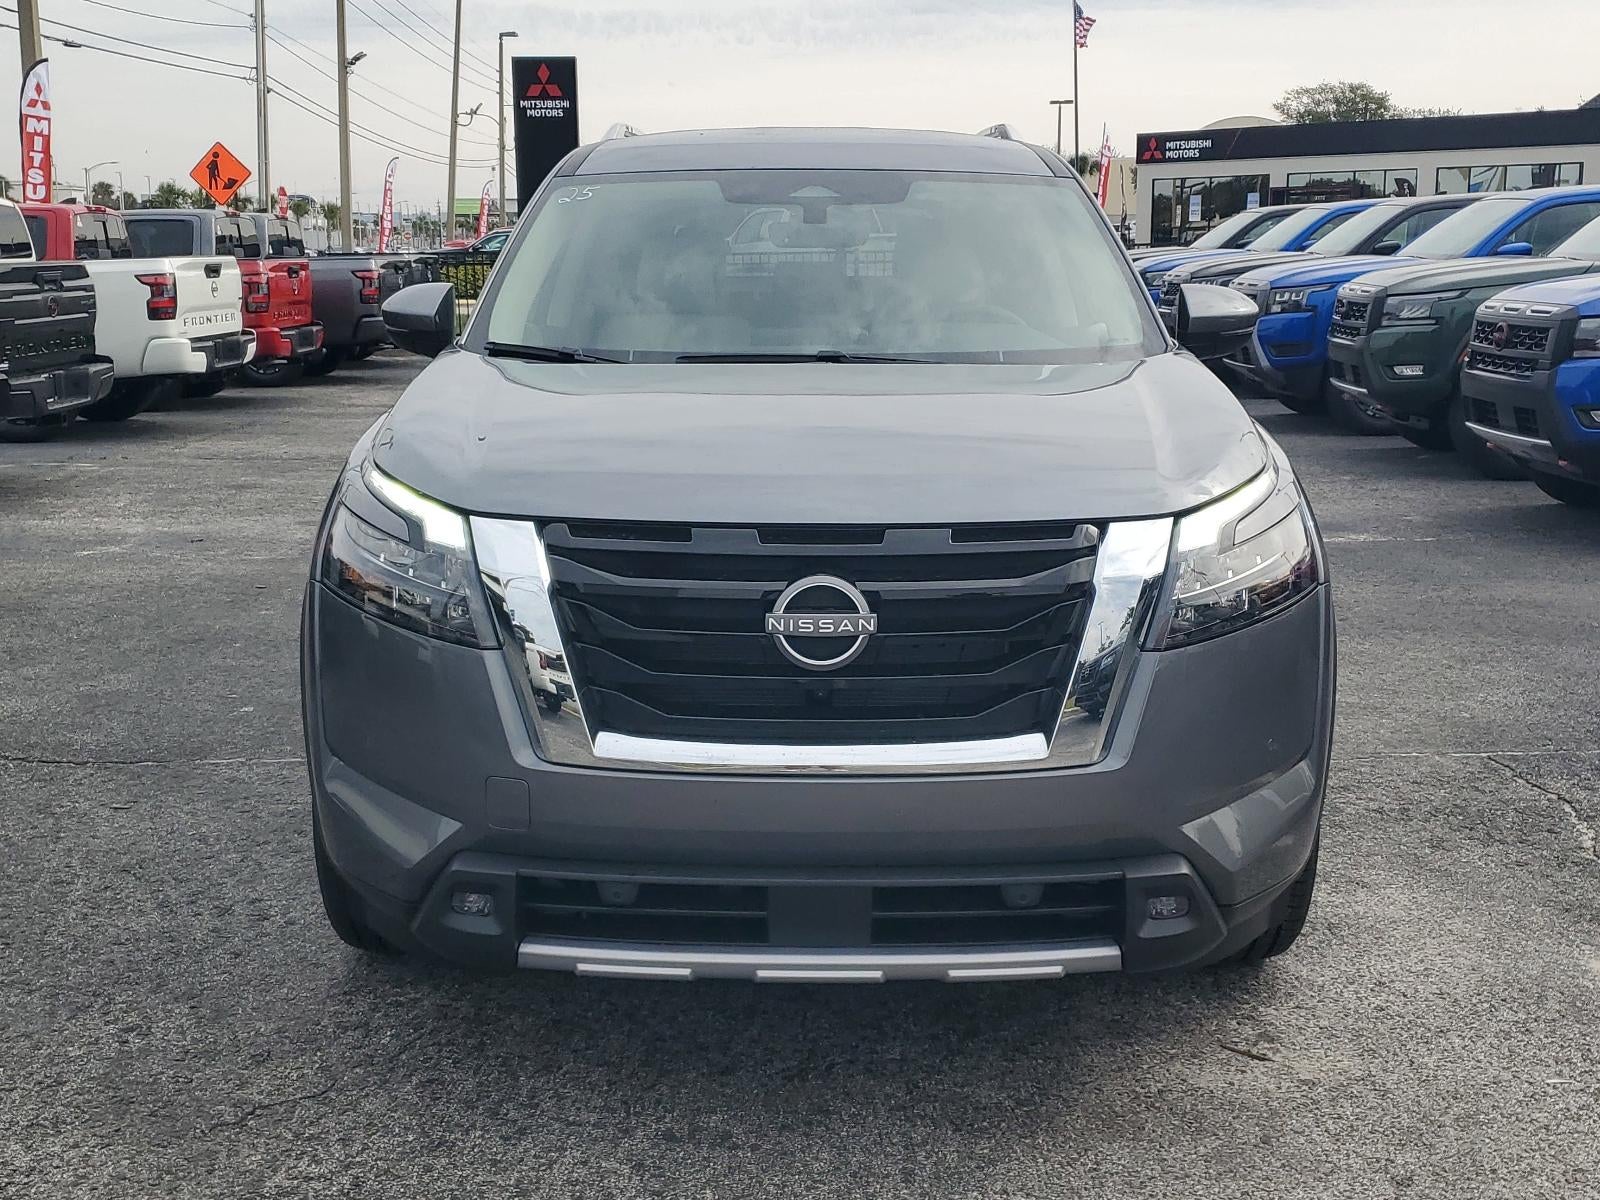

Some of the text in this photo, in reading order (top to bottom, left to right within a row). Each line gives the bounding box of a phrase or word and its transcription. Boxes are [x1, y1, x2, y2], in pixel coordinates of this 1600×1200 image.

[520, 100, 569, 108] MITSUBISHI
[526, 109, 563, 117] MOTORS
[1166, 139, 1212, 149] MITSUBISHI
[26, 117, 48, 203] MITSU
[1166, 150, 1200, 158] MOTORS
[559, 186, 600, 203] 25
[183, 313, 236, 327] FRONTIER
[768, 617, 874, 632] NISSAN
